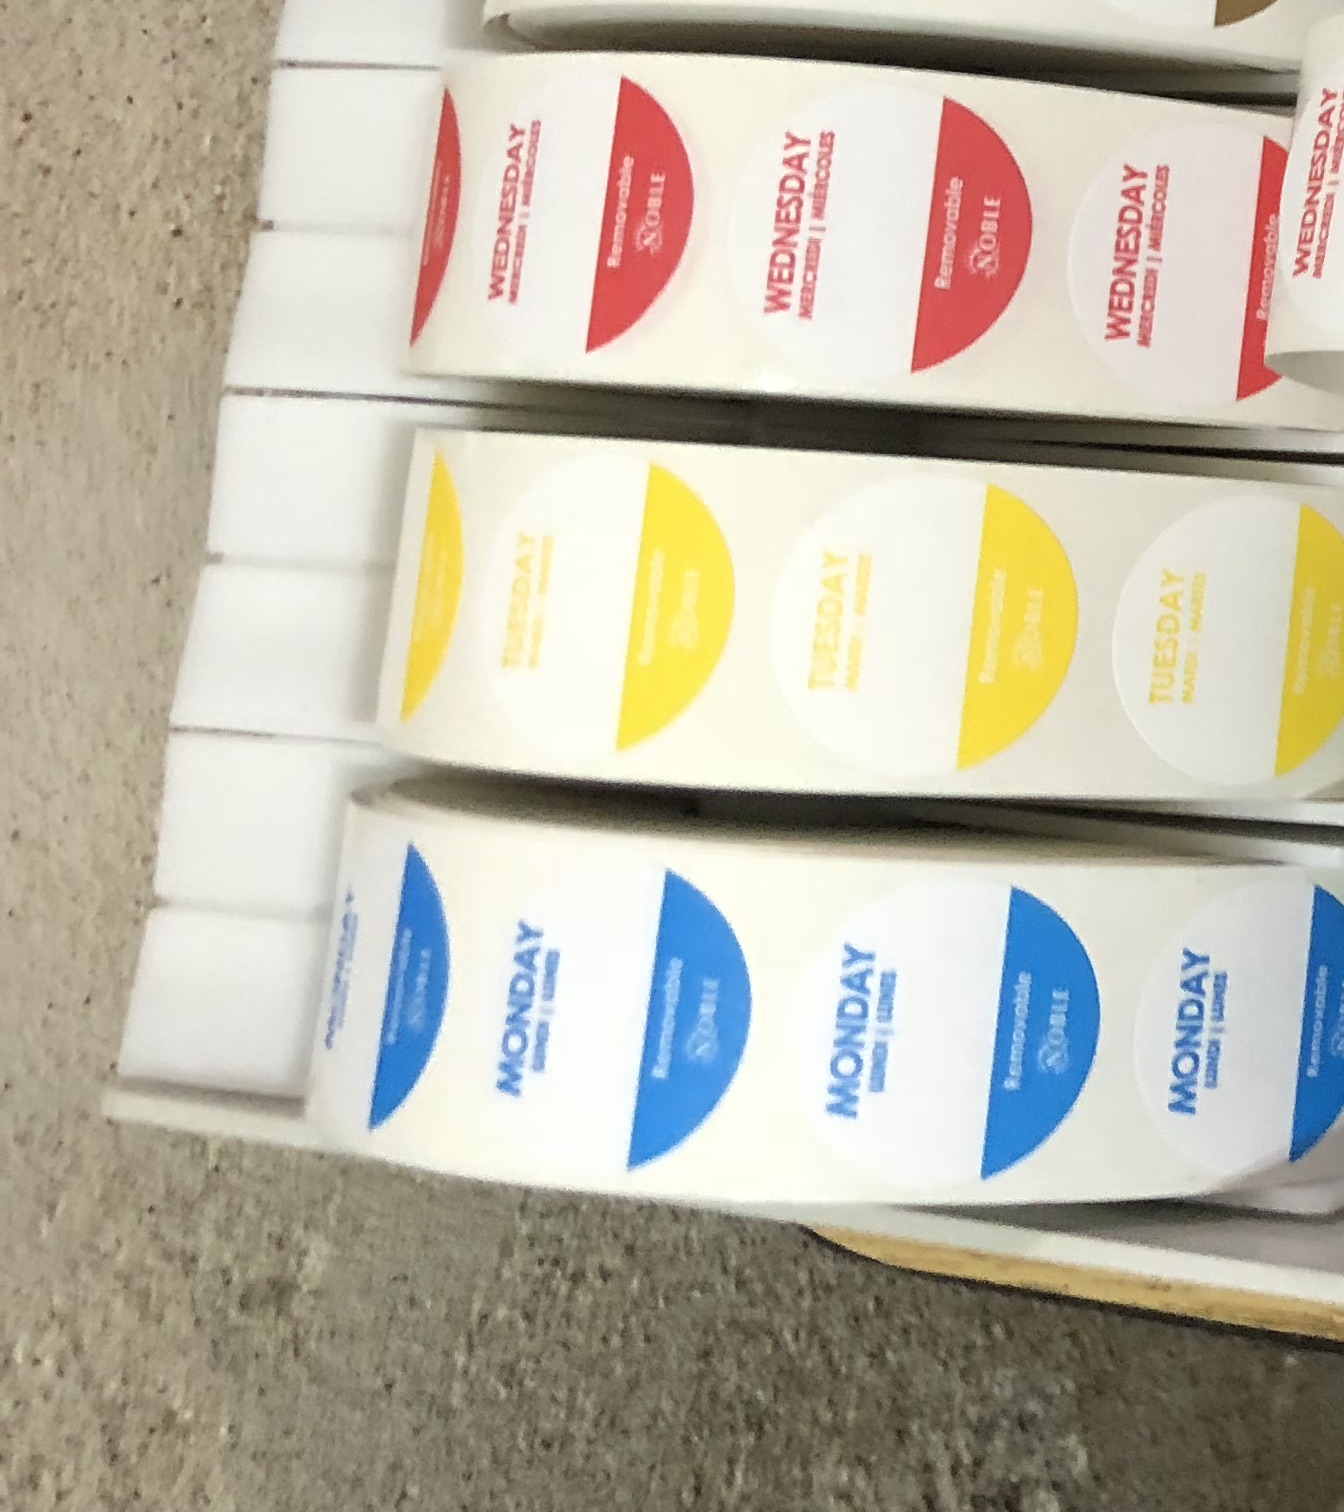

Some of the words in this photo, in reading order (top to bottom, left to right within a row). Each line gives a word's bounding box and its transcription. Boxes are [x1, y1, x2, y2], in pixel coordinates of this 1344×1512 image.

[487, 122, 526, 302] WEDNESDAY
[606, 154, 635, 270] Removable
[635, 169, 667, 257] NOBLE
[763, 131, 812, 315] WEDNESDAY
[934, 175, 964, 291] Removable
[966, 193, 1003, 284] NOBLE
[1292, 86, 1339, 279] WEDNESDAY
[1312, 190, 1336, 280] MERCREDI
[798, 236, 822, 321] MERCREDI
[1103, 163, 1149, 343] WEDNESDAY
[1137, 268, 1159, 349] MERCREDI
[502, 531, 538, 669] TUESDAY
[807, 550, 849, 691] TUESDAY
[1148, 568, 1185, 705] TUESDAY
[496, 920, 544, 1099] MONDAY
[652, 956, 684, 1080] Removable
[825, 942, 876, 1121] MONDAY
[876, 970, 898, 1023] LUNES
[1003, 970, 1033, 1091] Removable
[1038, 985, 1071, 1075] NOBLE
[1167, 947, 1211, 1115] MONDAY
[1306, 964, 1330, 1079] Removable
[868, 1040, 889, 1093] LUNDI
[1204, 1037, 1220, 1090] LUNDI
